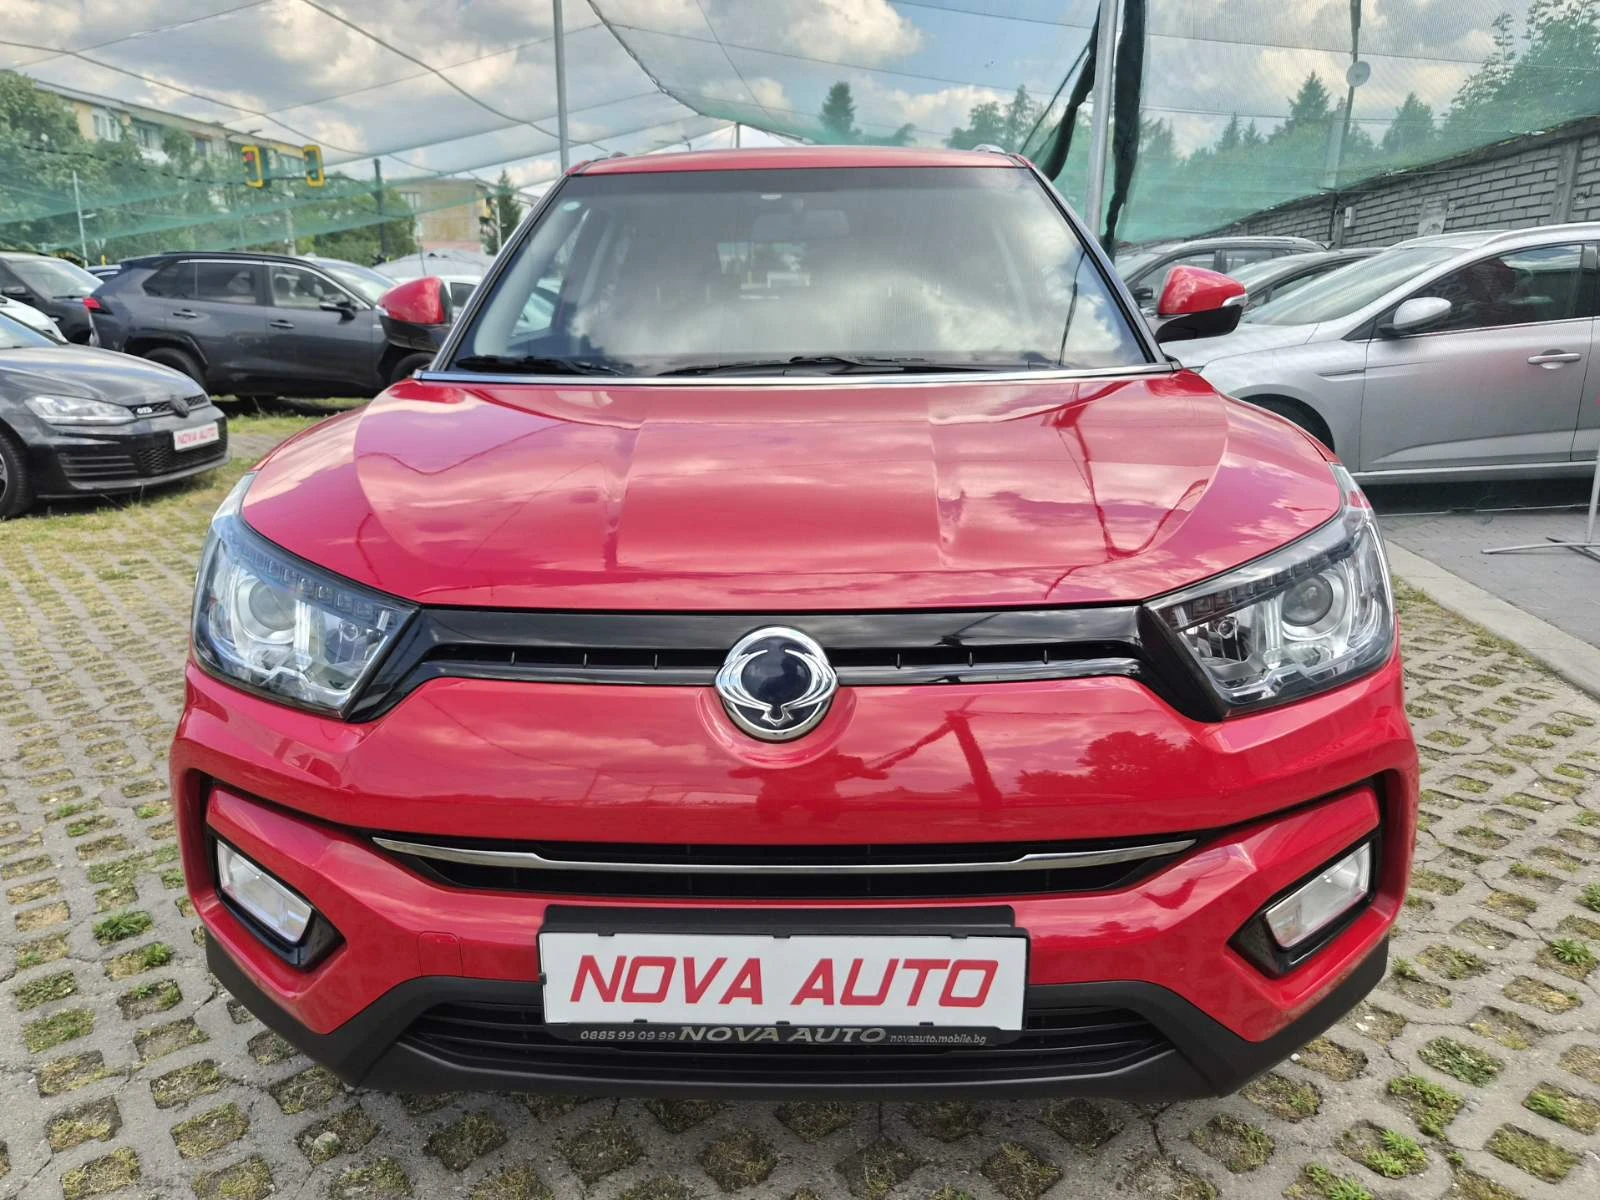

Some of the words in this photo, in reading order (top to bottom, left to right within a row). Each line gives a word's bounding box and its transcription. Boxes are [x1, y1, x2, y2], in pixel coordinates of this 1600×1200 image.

[570, 955, 763, 1005] NOVA
[790, 958, 999, 1008] AUTO
[618, 1031, 636, 1041] 99
[679, 1026, 781, 1042] NOVA
[786, 1027, 887, 1043] AUTO
[889, 1033, 988, 1045] novaauto.mobile.bg
